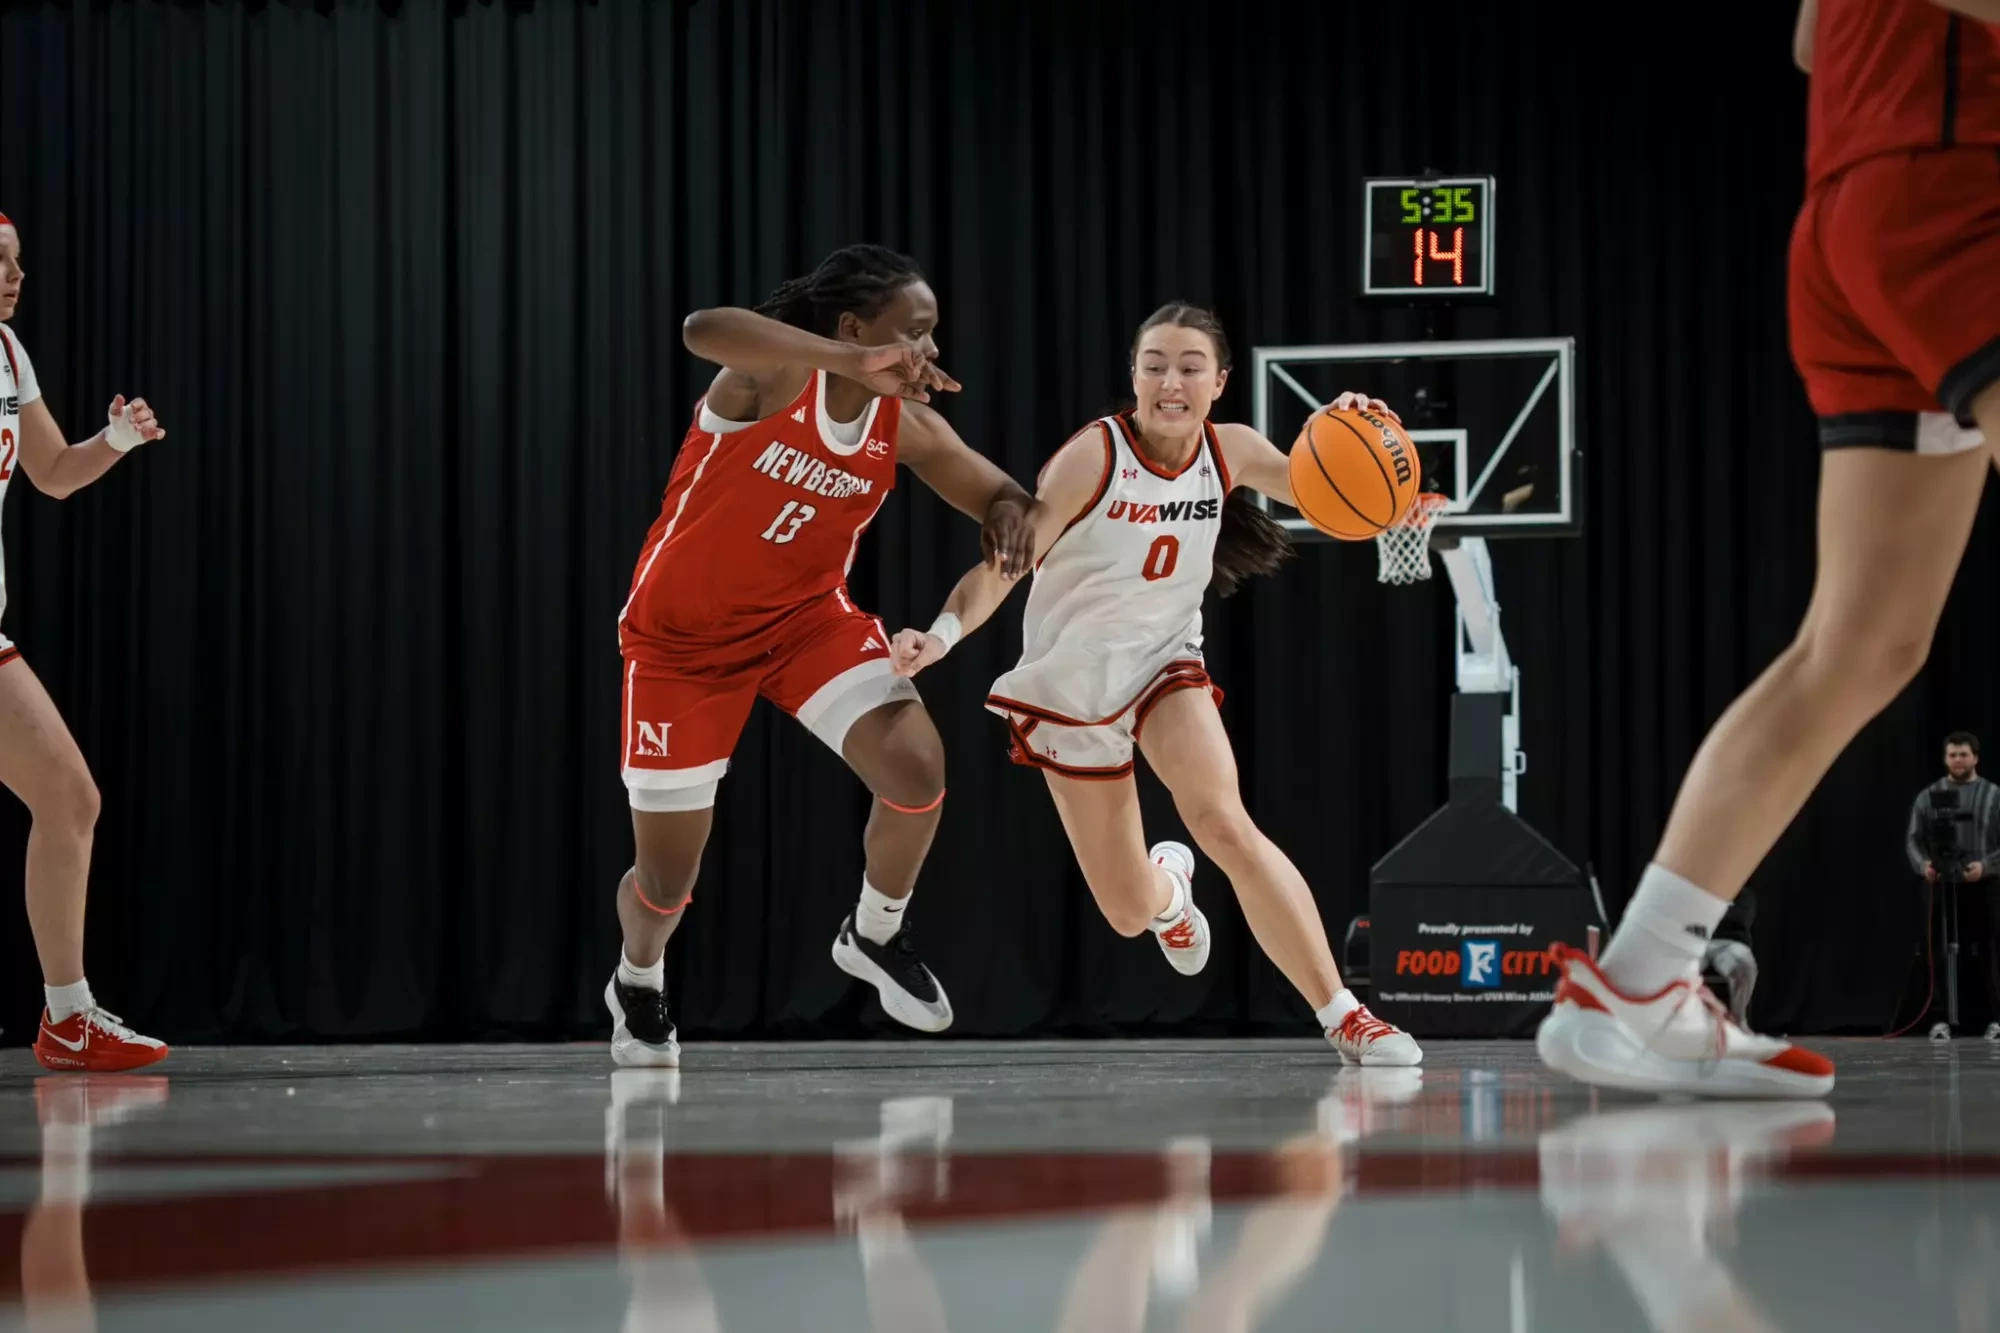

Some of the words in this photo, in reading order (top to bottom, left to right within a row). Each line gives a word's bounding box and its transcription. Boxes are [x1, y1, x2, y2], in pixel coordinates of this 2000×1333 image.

[1401, 188, 1474, 223] 5:35
[1415, 227, 1463, 285] 14
[0, 428, 15, 480] 2
[866, 438, 889, 454] SAC
[760, 500, 817, 544] 13
[1142, 534, 1180, 582] 0
[635, 720, 673, 757] N
[1418, 923, 1460, 936] Proudly
[1461, 924, 1517, 935] presented
[1519, 924, 1534, 936] by
[1396, 951, 1460, 975] FOOD
[1502, 951, 1553, 975] CITY
[1379, 992, 1394, 1001] The
